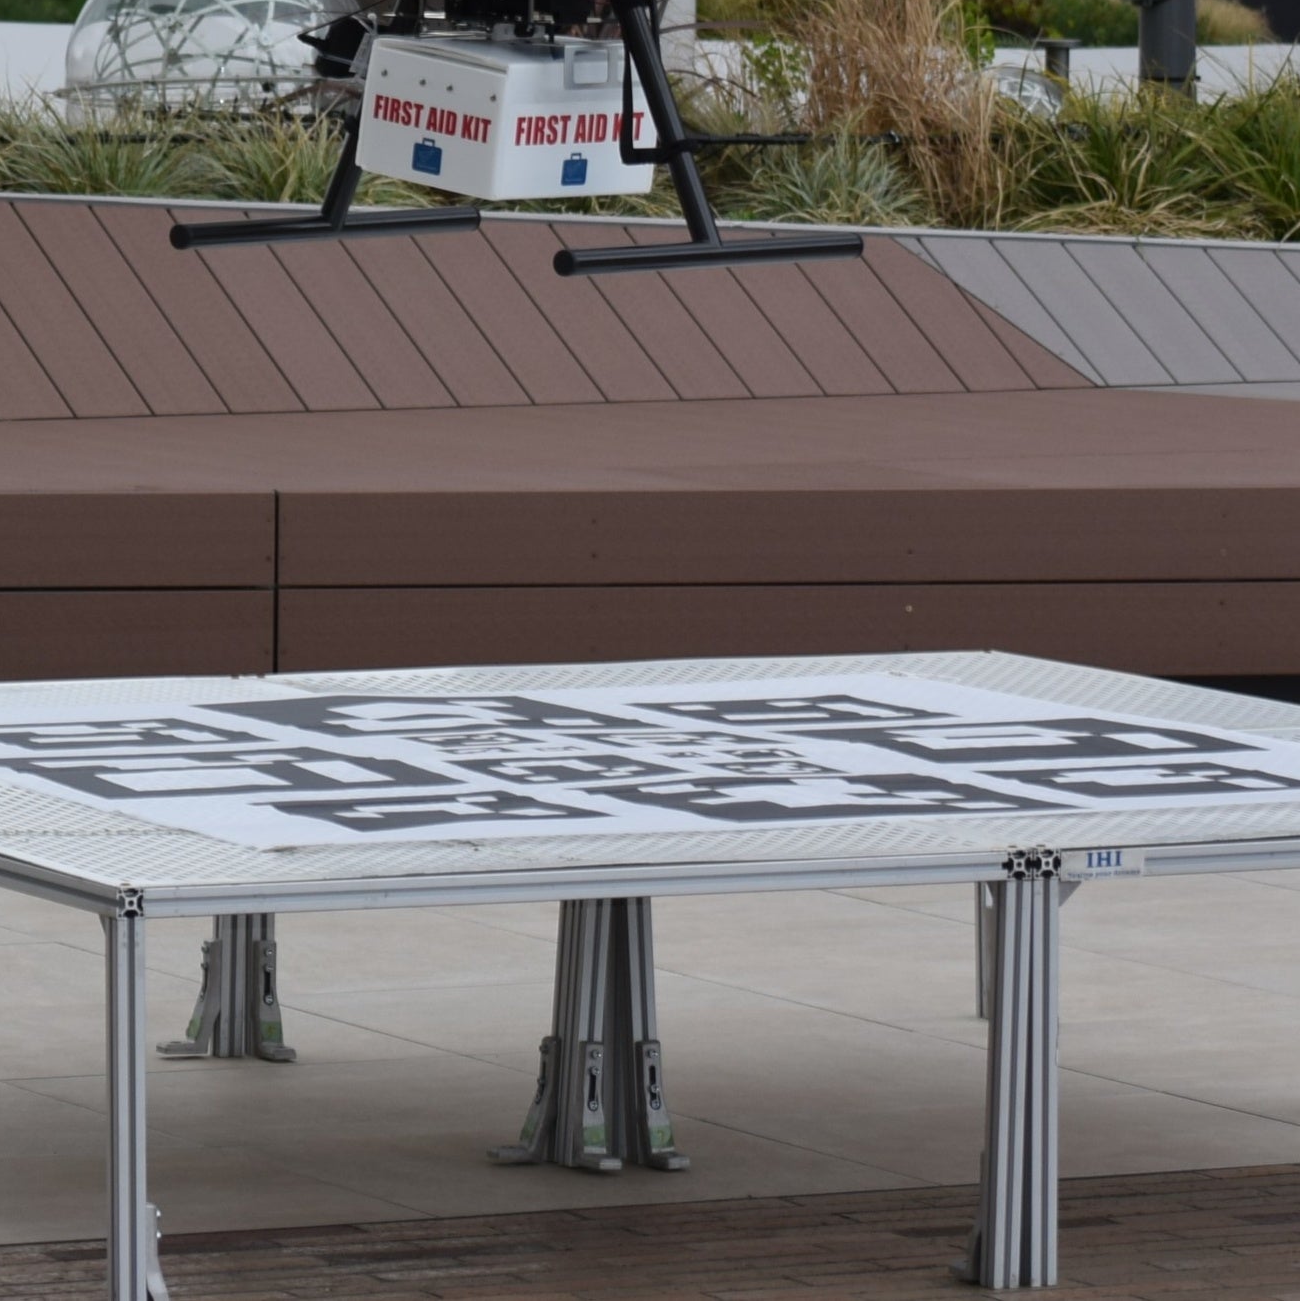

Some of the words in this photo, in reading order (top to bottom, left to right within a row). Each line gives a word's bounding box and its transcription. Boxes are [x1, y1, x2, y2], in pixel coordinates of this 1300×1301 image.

[373, 94, 423, 128] FIRST
[426, 107, 457, 136] AID
[461, 115, 492, 143] KIT
[515, 115, 571, 146] FIRST
[574, 113, 607, 144] AID
[612, 112, 645, 143] KT
[1086, 851, 1122, 868] IHI
